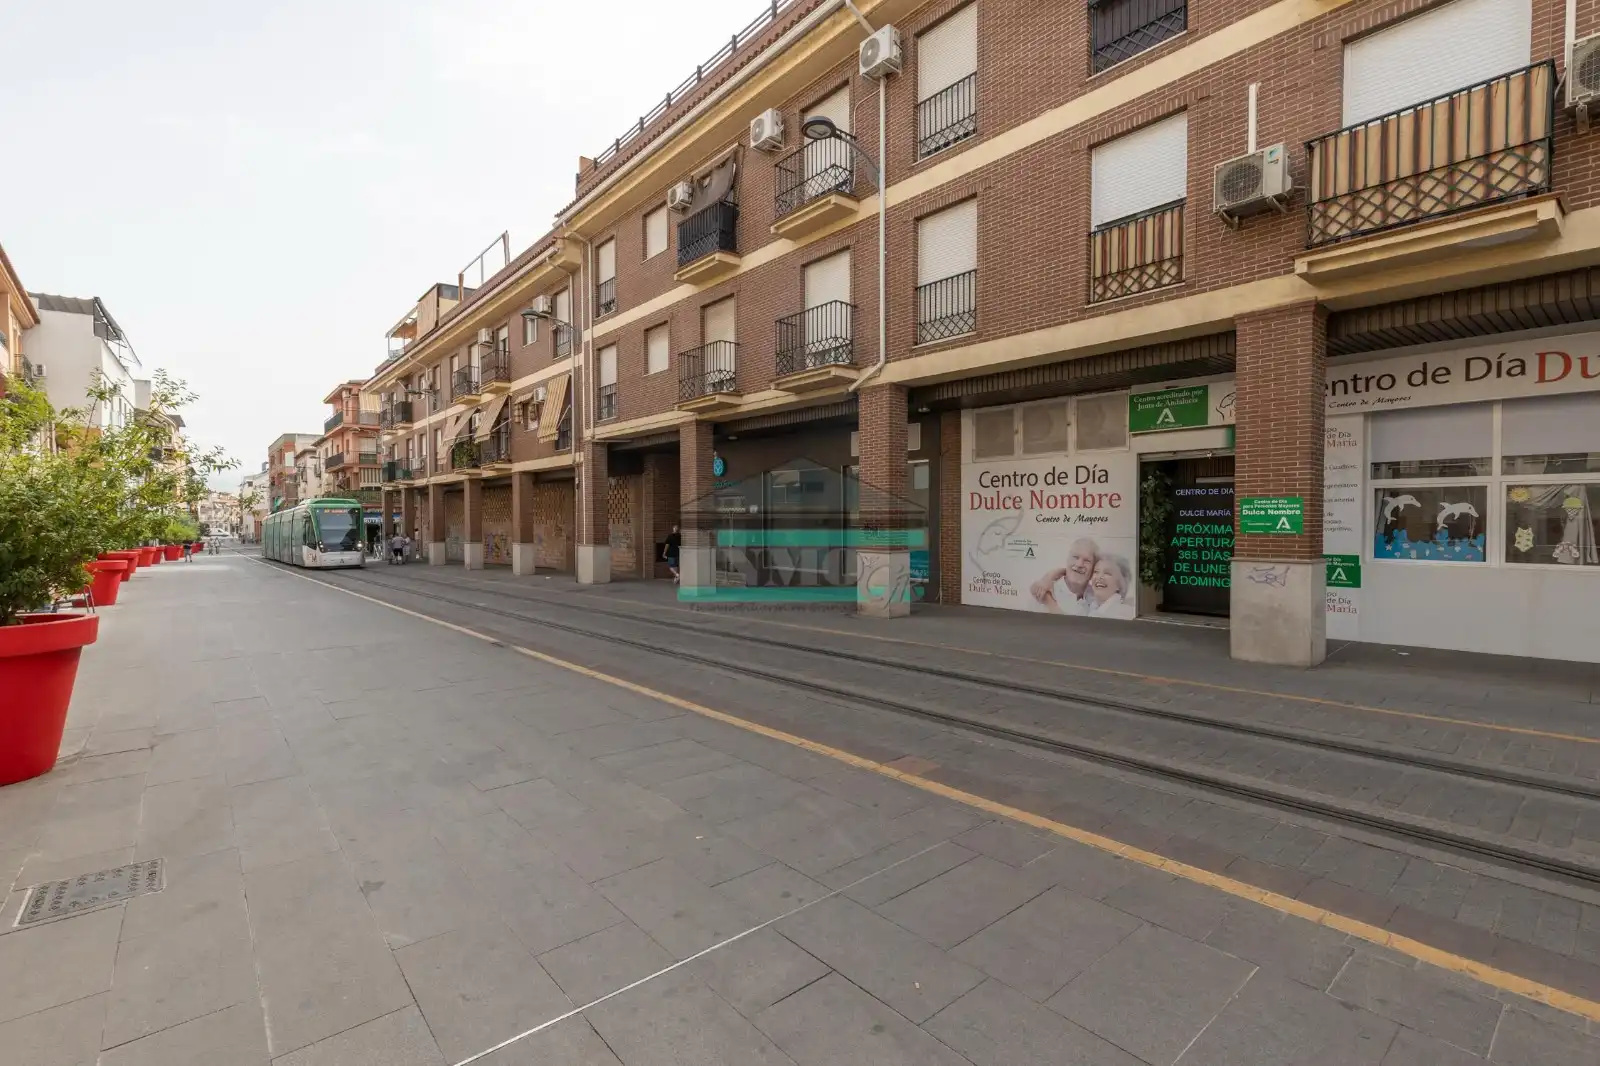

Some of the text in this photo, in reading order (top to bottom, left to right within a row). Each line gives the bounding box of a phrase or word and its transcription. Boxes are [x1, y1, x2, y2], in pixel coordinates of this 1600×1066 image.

[1407, 362, 1450, 386] de
[1465, 352, 1526, 382] Día
[1157, 390, 1190, 400] acreditado
[1191, 389, 1203, 397] por
[1372, 396, 1411, 405] Mayores
[979, 464, 1108, 489] Centro de Día
[970, 487, 1122, 510] Dulce Nombre
[1036, 514, 1060, 523] Centro
[1074, 514, 1108, 525] Mayores
[1176, 522, 1233, 534] PRÓXIMA
[1178, 549, 1232, 560] 365 DÍAS
[1174, 563, 1191, 572] DE
[1168, 575, 1177, 584] A
[969, 584, 991, 593] Dulce
